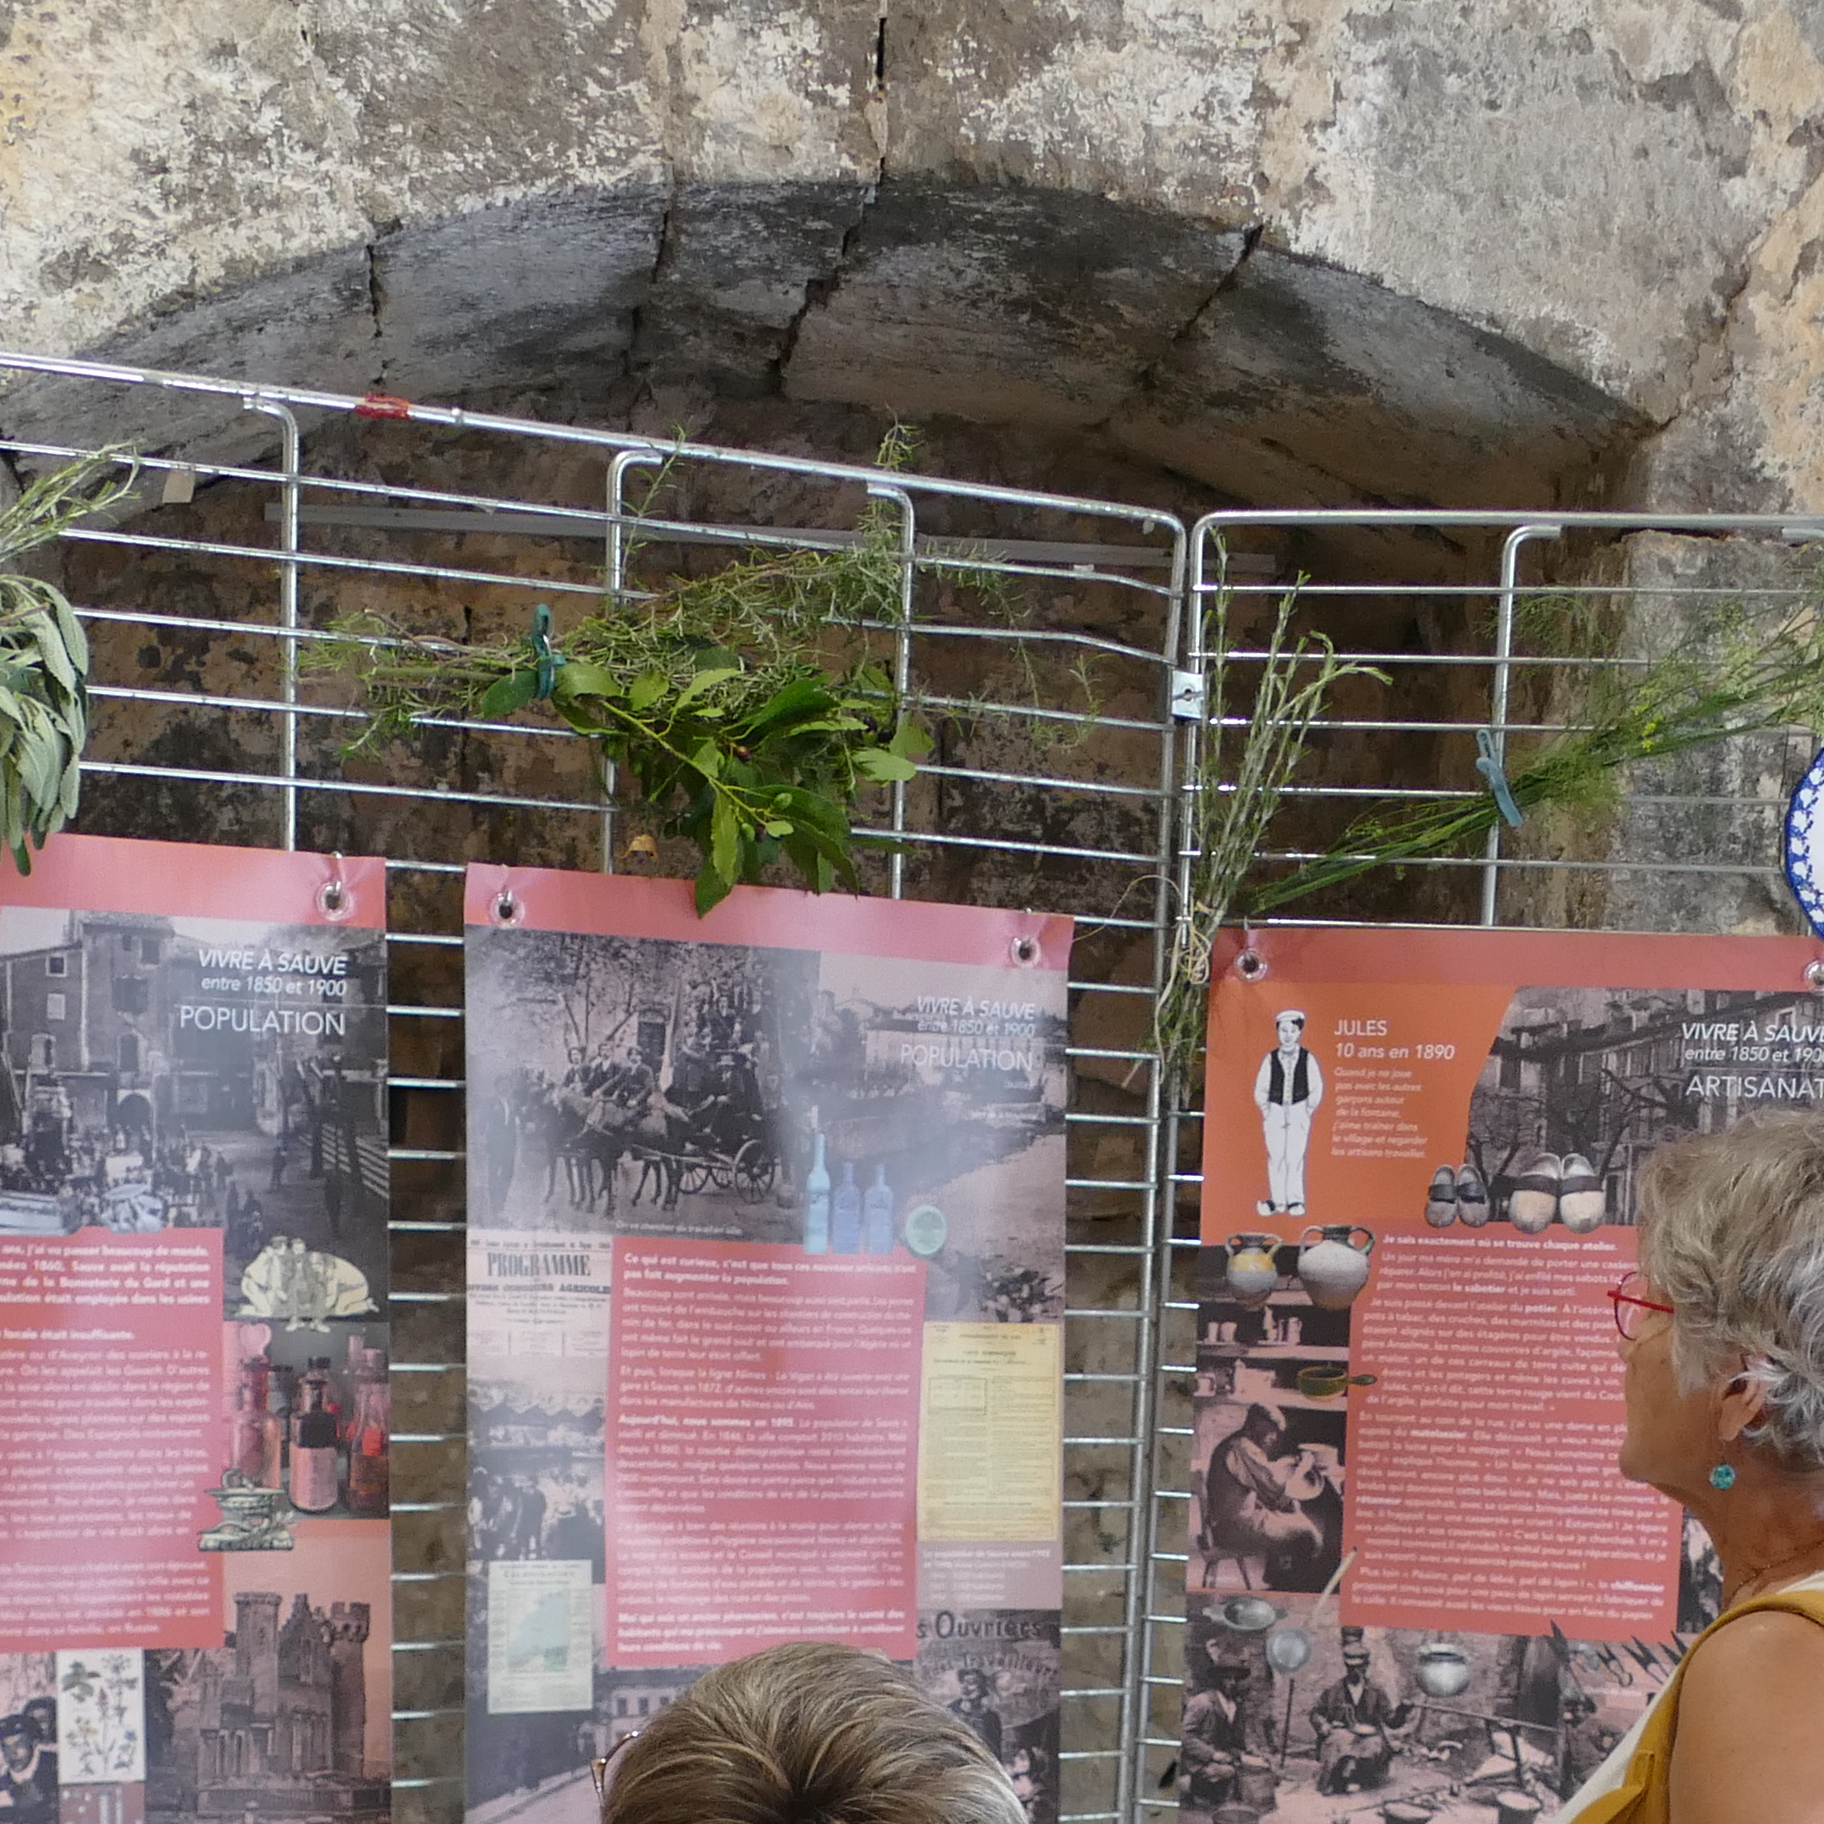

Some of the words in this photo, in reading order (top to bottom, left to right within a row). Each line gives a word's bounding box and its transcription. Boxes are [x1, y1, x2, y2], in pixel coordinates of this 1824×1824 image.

[199, 949, 254, 971] VIVRE
[258, 948, 273, 971] À
[277, 953, 349, 975] SAUVE
[201, 976, 241, 992] entre
[246, 976, 283, 994] 1850
[285, 979, 302, 995] et
[308, 979, 347, 997] 1900
[917, 996, 960, 1016] VIVRE
[963, 996, 974, 1017] À
[979, 1000, 1036, 1020] SAUVE
[180, 1005, 346, 1036] POPULATION
[918, 1018, 948, 1033] entre
[954, 1019, 984, 1035] 1850
[986, 1023, 1000, 1035] et
[1005, 1022, 1035, 1038] 1900
[1334, 1020, 1388, 1036] JULES
[1682, 1022, 1739, 1041] VIVRE
[1743, 1020, 1758, 1041] À
[901, 1044, 1033, 1072] POPULATION
[1336, 1043, 1354, 1058] 10
[1357, 1047, 1385, 1059] ans
[1389, 1048, 1409, 1059] en
[1416, 1044, 1455, 1060] 1890
[1685, 1048, 1725, 1060] entre
[1731, 1046, 1769, 1061] 1850
[1772, 1049, 1789, 1062] et
[487, 1252, 592, 1277] PROGRAMME
